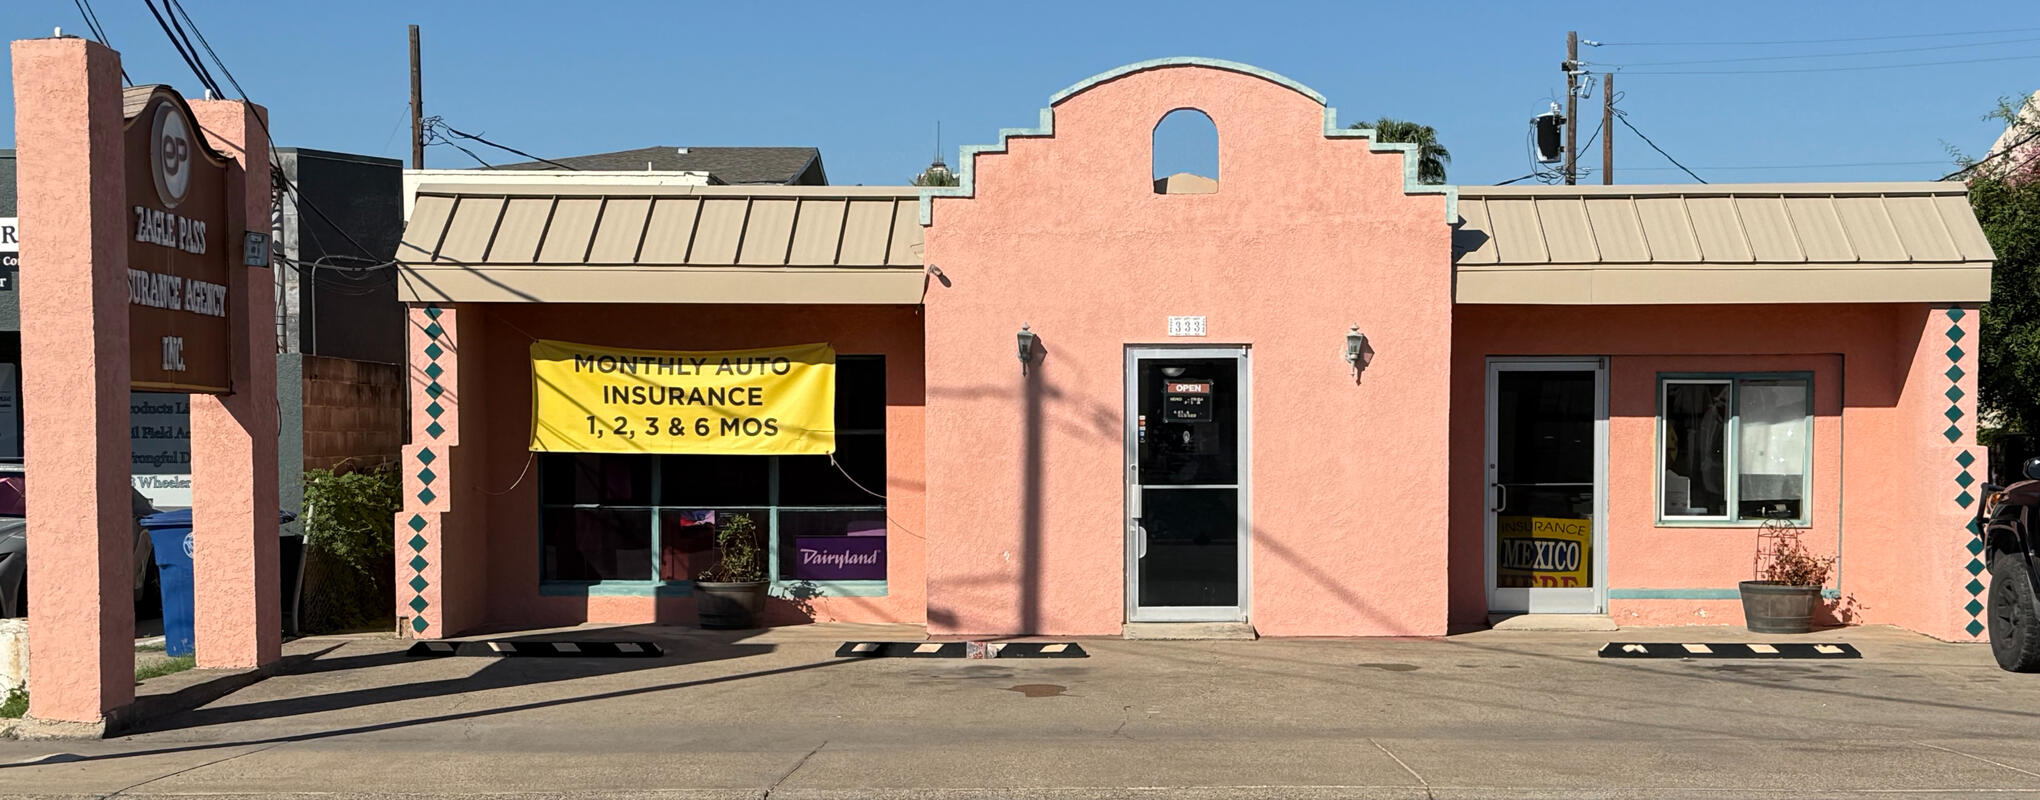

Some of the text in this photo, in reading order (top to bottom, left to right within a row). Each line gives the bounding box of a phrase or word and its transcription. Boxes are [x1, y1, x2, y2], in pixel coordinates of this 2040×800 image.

[178, 215, 207, 255] PASS
[2, 255, 20, 266] Co
[183, 278, 227, 318] AGENCY
[1175, 320, 1201, 333] 333
[162, 335, 186, 372] INC.
[575, 353, 792, 376] MONTHLY AUTO
[603, 384, 763, 406] INSURANCE
[1175, 384, 1202, 392] OPEN
[142, 426, 174, 439] Field
[586, 415, 779, 440] 1, 2, 3 & 6 MOS
[136, 476, 191, 489] Wheeler
[1502, 520, 1587, 537] INSURANCE
[800, 548, 878, 569] Dairyland
[1502, 539, 1580, 571] MEXICO
